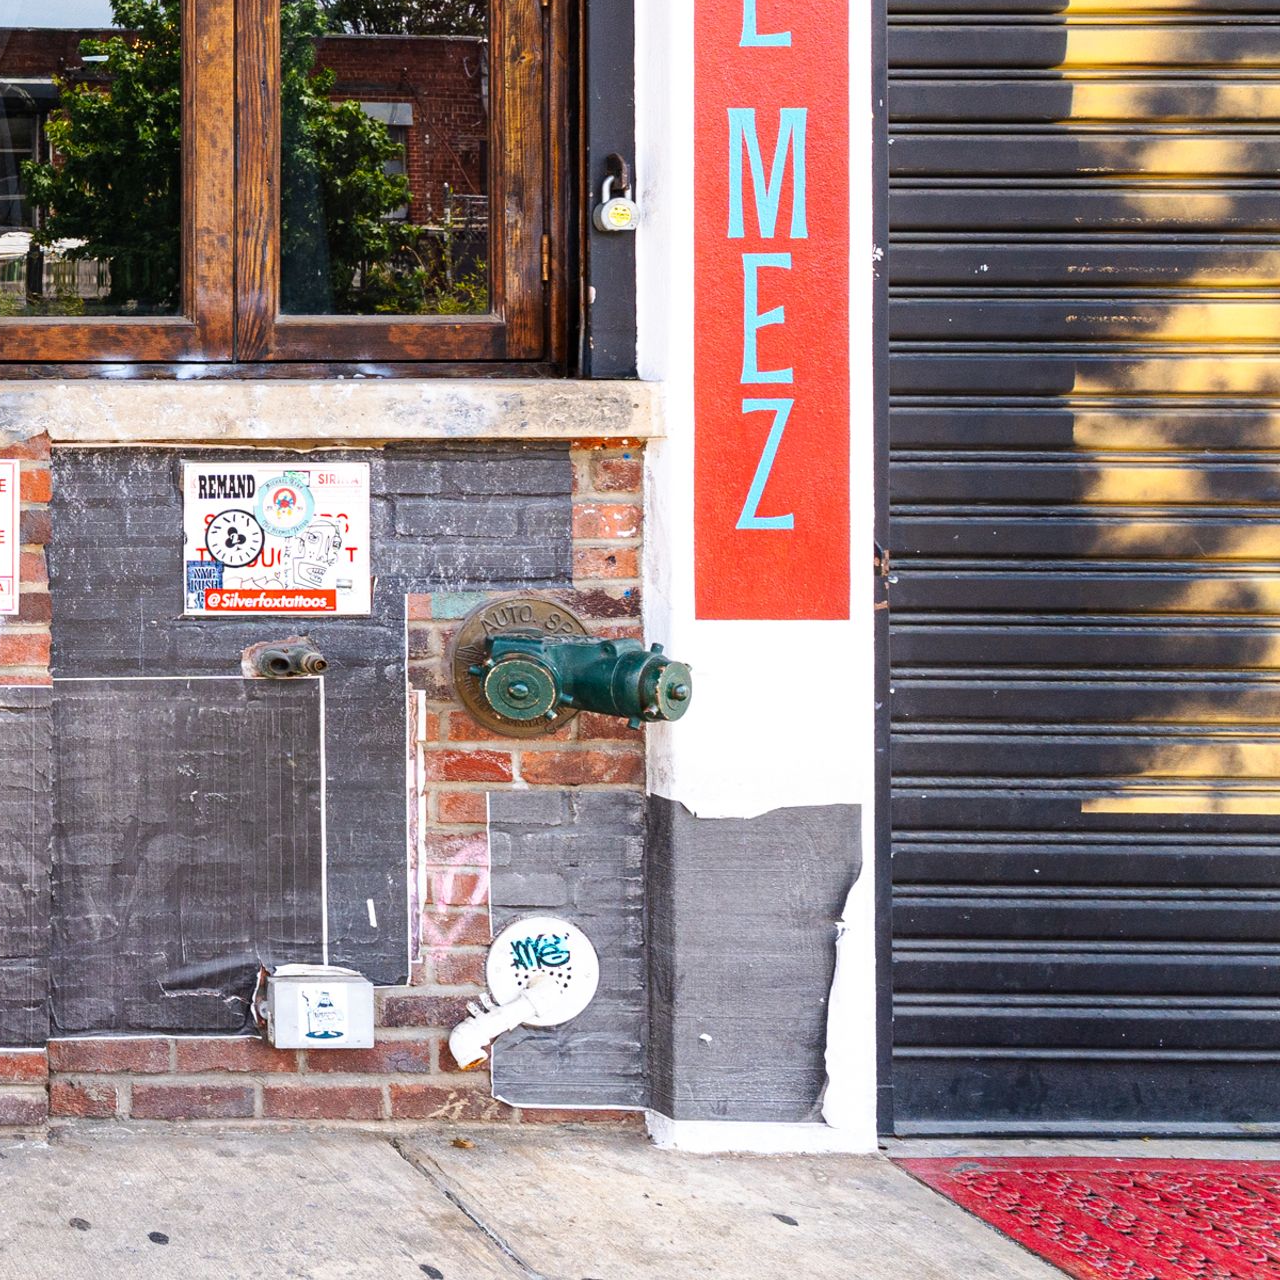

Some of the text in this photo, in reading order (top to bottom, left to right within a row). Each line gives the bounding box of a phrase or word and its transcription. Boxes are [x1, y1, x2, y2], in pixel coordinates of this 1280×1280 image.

[727, 107, 809, 530] MEZ
[198, 474, 257, 500] REMAND
[207, 592, 335, 609] @Silverfoxtattoos_
